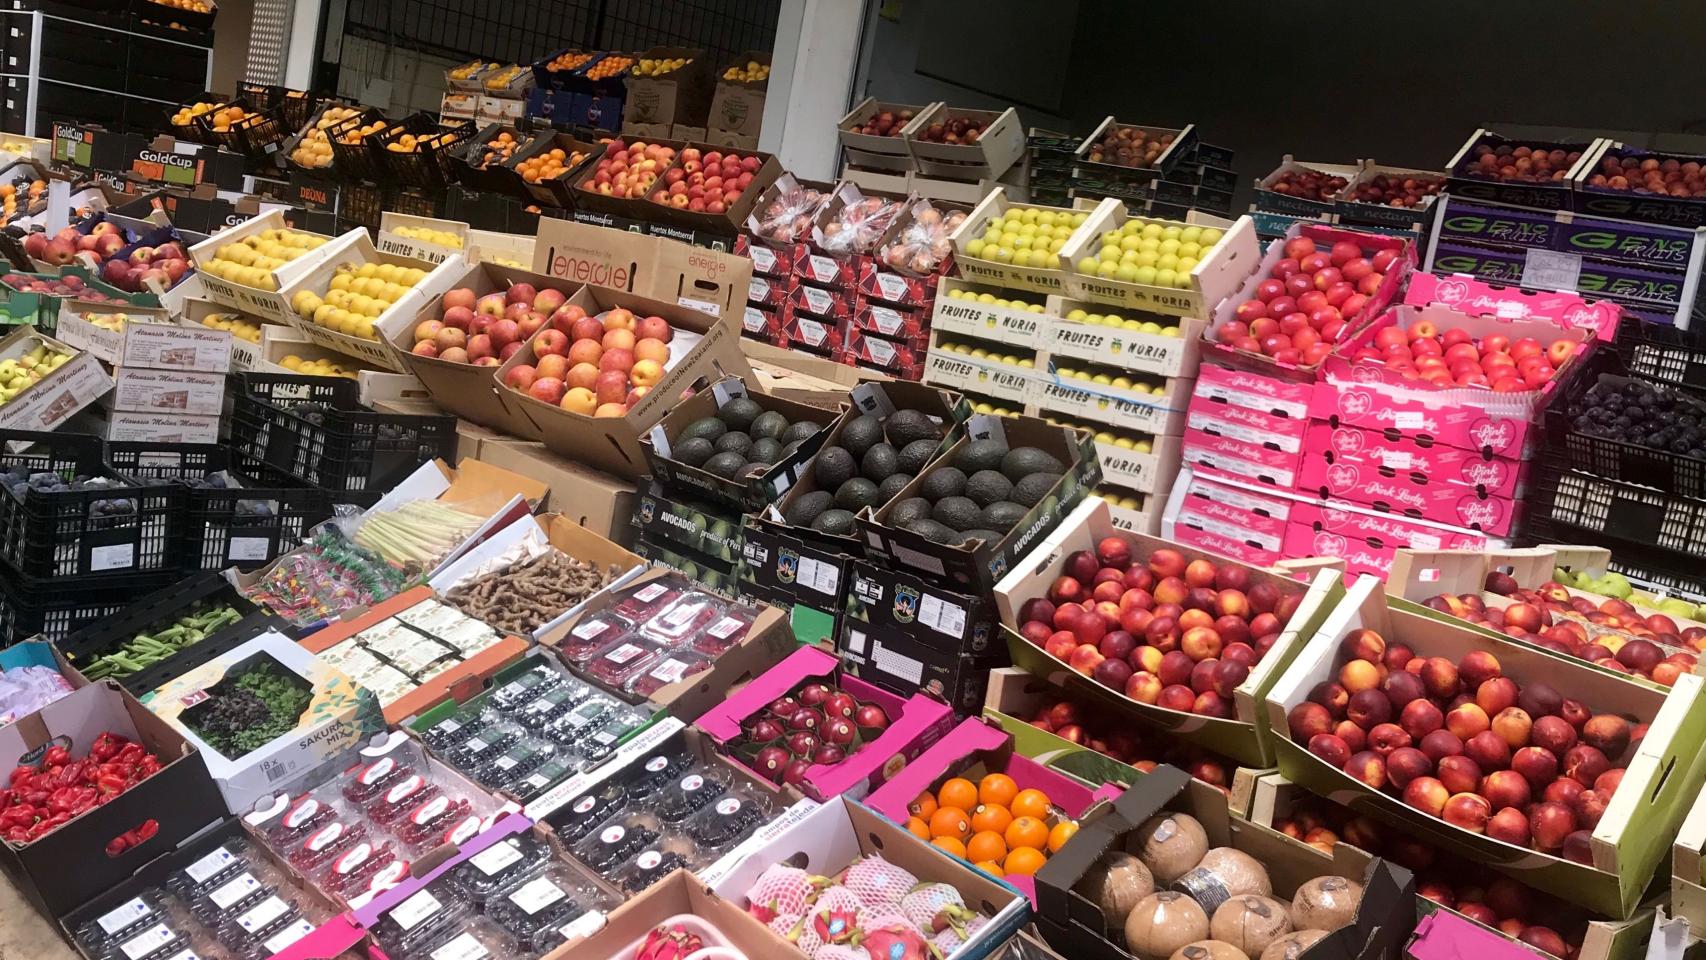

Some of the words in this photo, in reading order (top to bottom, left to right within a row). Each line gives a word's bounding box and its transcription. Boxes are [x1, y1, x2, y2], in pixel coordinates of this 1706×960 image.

[57, 126, 83, 142] GoldCup
[140, 150, 193, 168] GoldCup
[1444, 216, 1549, 234] GENO
[1492, 228, 1548, 243] FRUITS
[1570, 232, 1688, 250] GENO
[382, 240, 412, 256] FRUITES
[1624, 245, 1688, 261] FRUITS
[966, 264, 1004, 278] FRUITES
[1435, 256, 1523, 273] GEN
[1082, 282, 1126, 298] FRUITES
[940, 304, 982, 320] FRUITES
[1057, 328, 1104, 347] FRUITES
[932, 358, 972, 376] FRUITES
[1044, 384, 1090, 403] FRUITES
[1470, 424, 1507, 437] Pink
[1478, 434, 1510, 448] Lady
[1462, 464, 1498, 476] Pink
[1473, 474, 1503, 488] Lady
[1358, 482, 1394, 496] Pink
[1394, 485, 1428, 510] Lady
[1456, 502, 1494, 516] Pink
[660, 511, 696, 533] AVOCADOS
[1352, 517, 1391, 534] Pink
[1013, 514, 1051, 556] AVOCADOS
[300, 720, 344, 750] SAKURA
[326, 729, 348, 746] MIX
